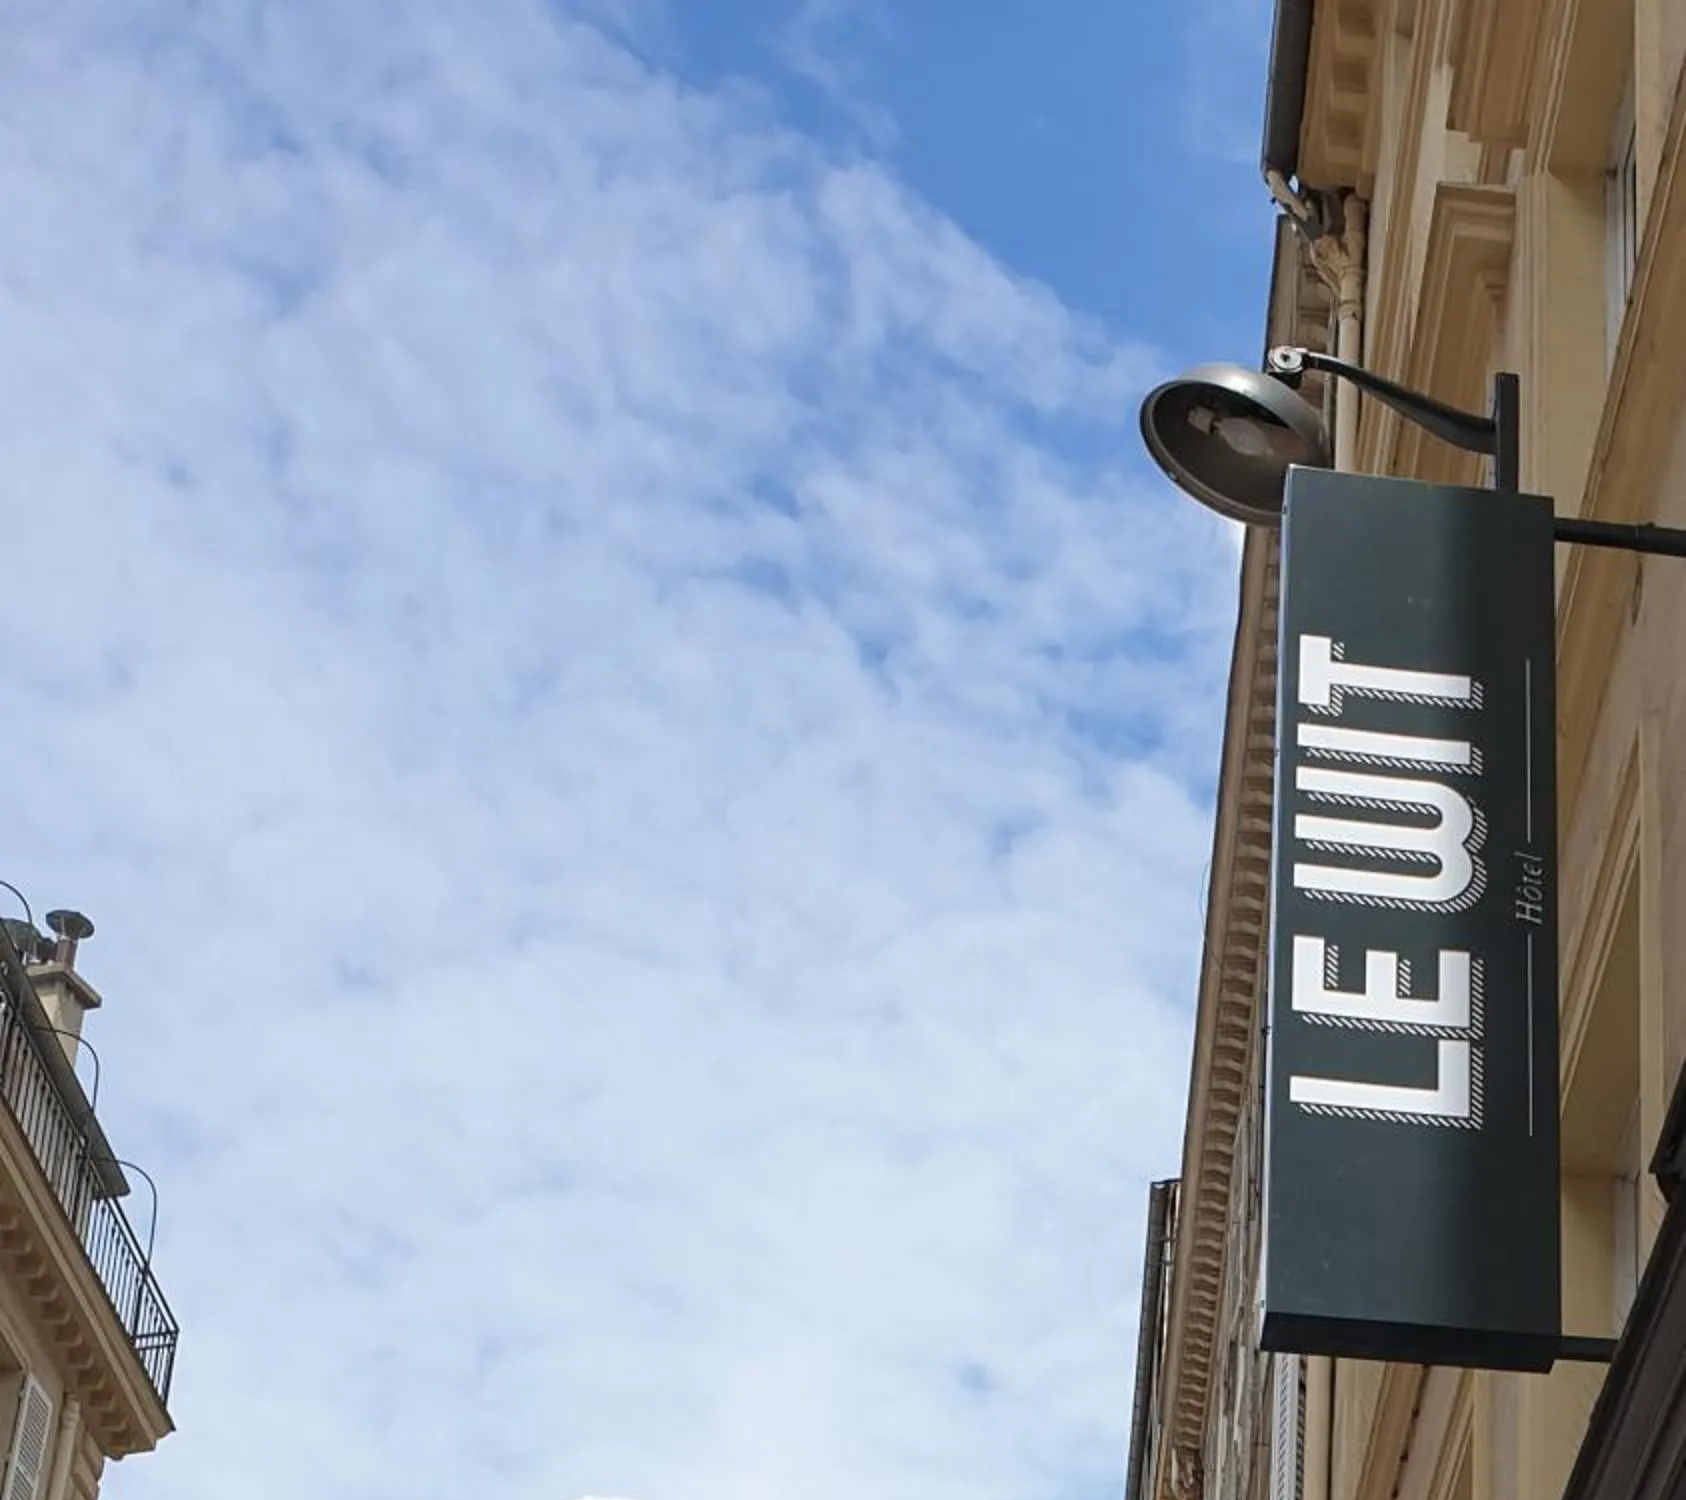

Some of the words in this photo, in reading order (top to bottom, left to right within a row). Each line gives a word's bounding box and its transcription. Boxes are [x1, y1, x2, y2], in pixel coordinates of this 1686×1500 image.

[1293, 634, 1488, 914] WIT
[1513, 851, 1545, 925] Hôtel
[1289, 935, 1485, 1130] LE
